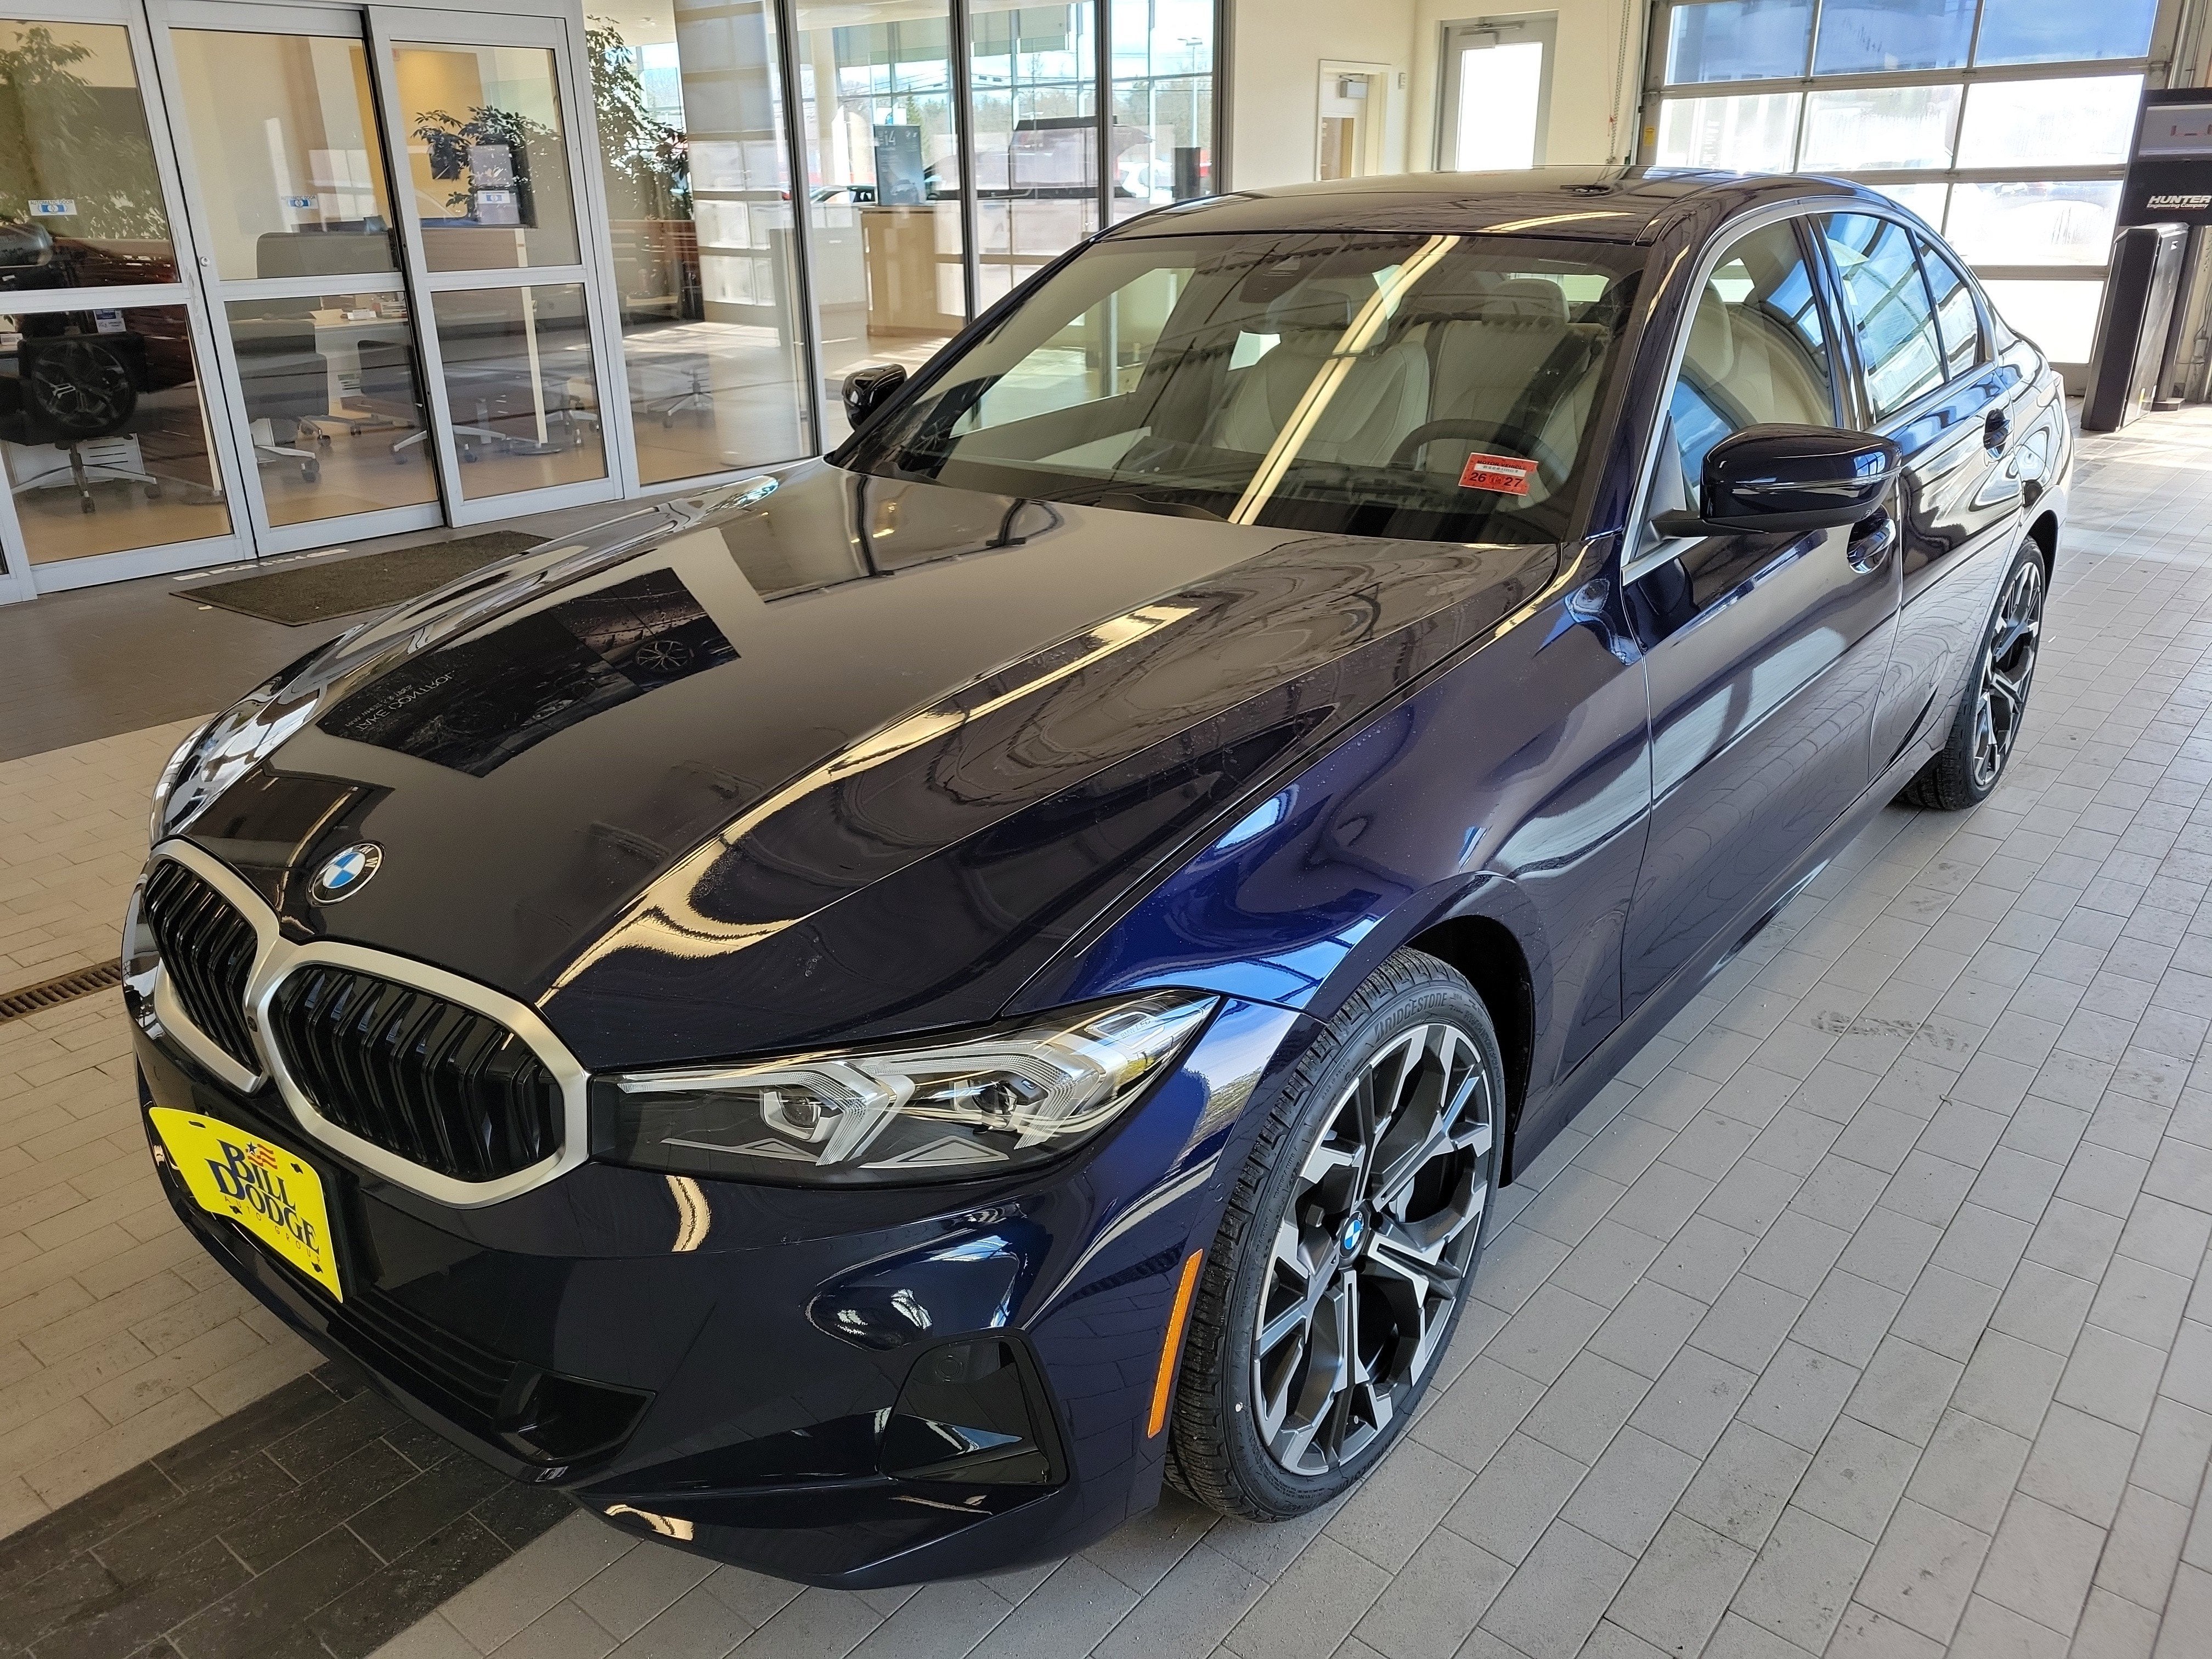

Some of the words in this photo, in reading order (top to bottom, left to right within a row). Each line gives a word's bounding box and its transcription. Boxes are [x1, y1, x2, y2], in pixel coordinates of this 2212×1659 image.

[2148, 195, 2212, 204] HUNTER
[1469, 472, 1487, 482] 26
[1504, 477, 1523, 487] 27
[1374, 992, 1447, 1043] BRIDGESTONE
[216, 1139, 296, 1212] BILL
[204, 1158, 320, 1256] DODGE
[224, 1195, 262, 1222] AUTO
[274, 1226, 320, 1265] GROUP
